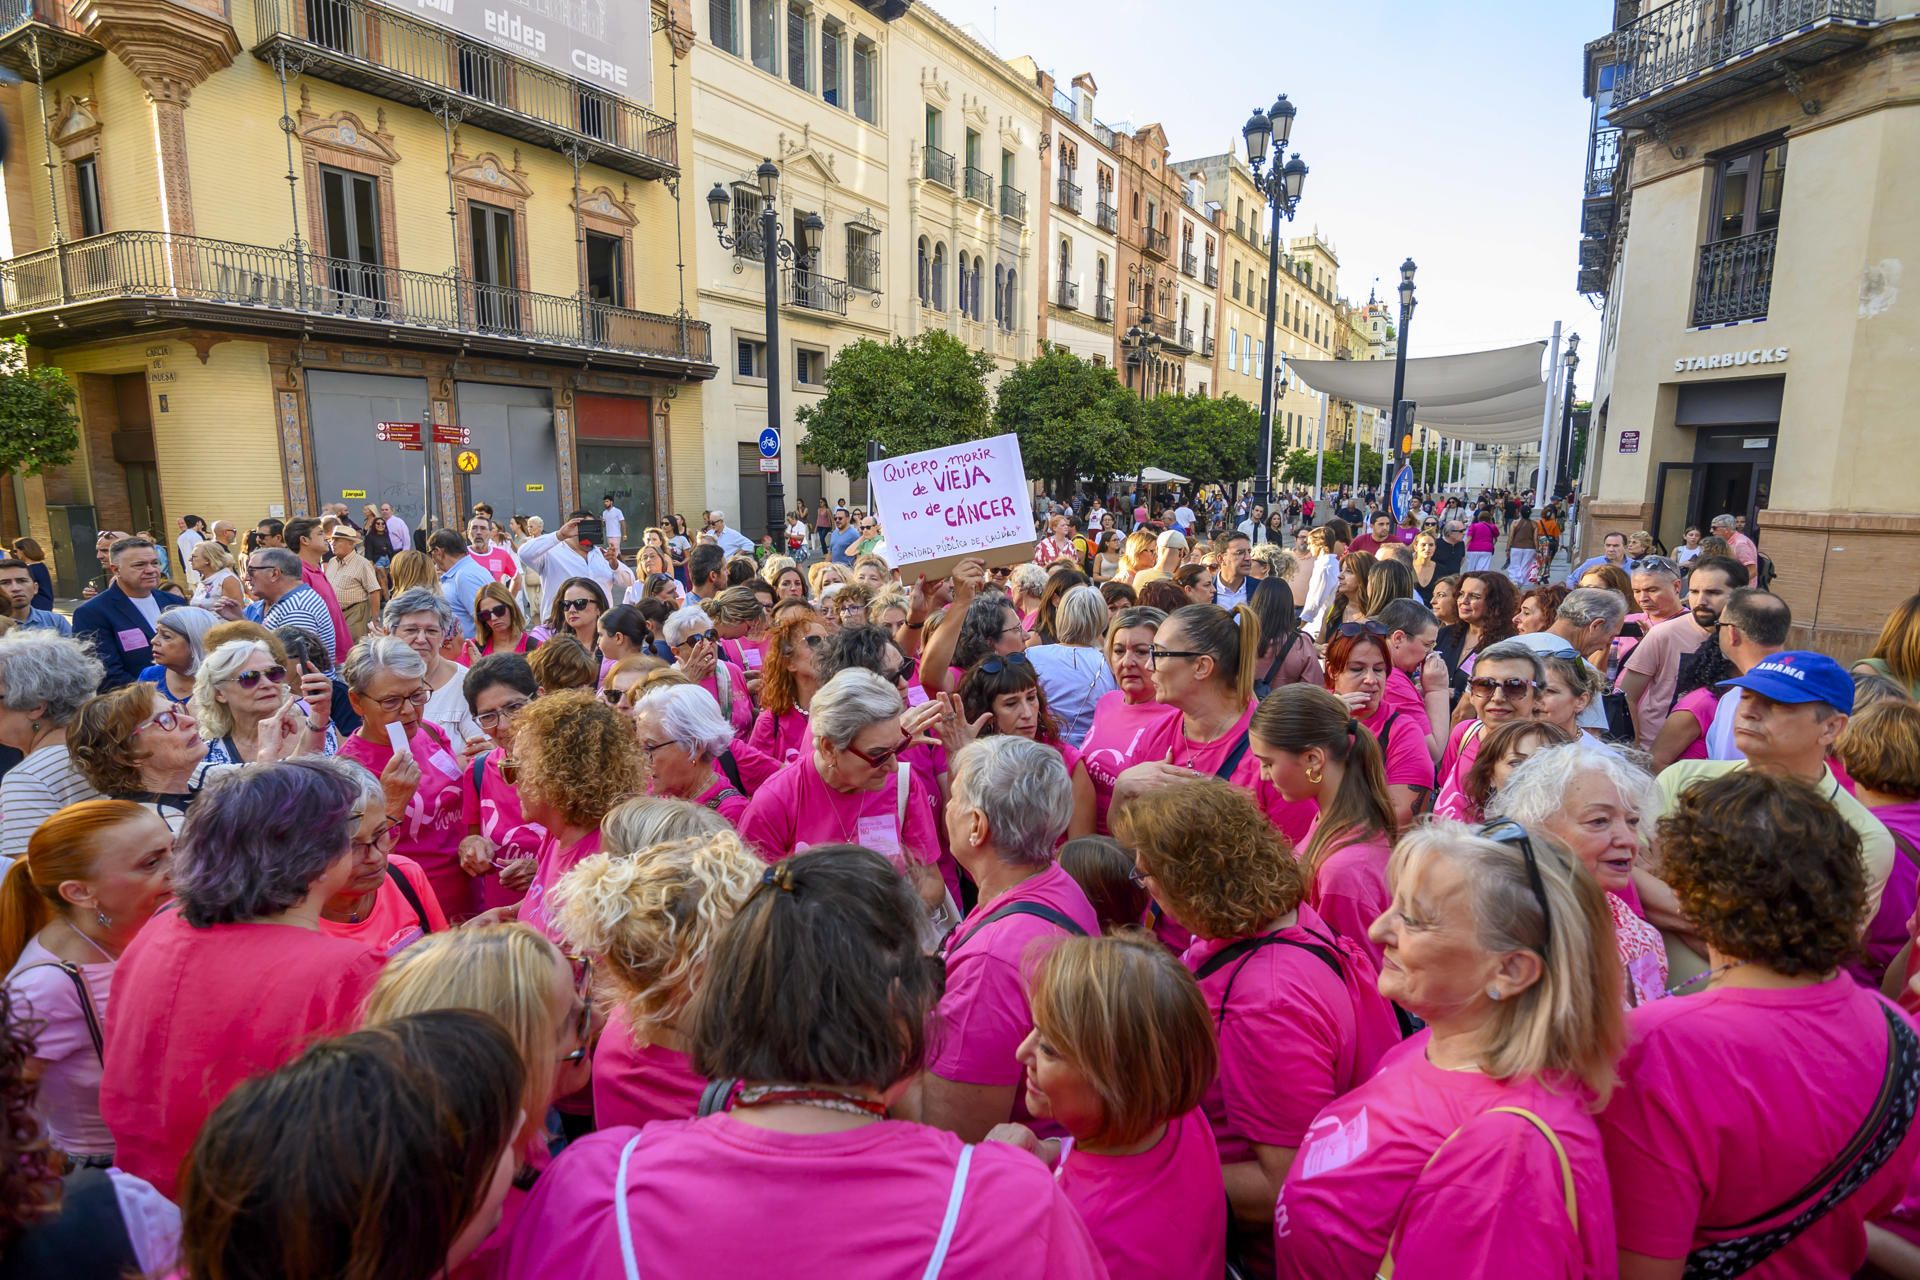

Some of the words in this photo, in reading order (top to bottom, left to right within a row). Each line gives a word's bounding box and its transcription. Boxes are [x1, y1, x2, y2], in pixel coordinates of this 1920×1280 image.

[484, 8, 546, 51] eddea
[571, 49, 628, 87] CBRE
[1674, 346, 1789, 372] STARBUCKS
[912, 482, 929, 496] de
[933, 464, 991, 492] VIEJA
[902, 510, 918, 521] no
[925, 502, 942, 516] de
[944, 496, 1016, 527] CÁNCER
[1756, 662, 1805, 680] AMAMA
